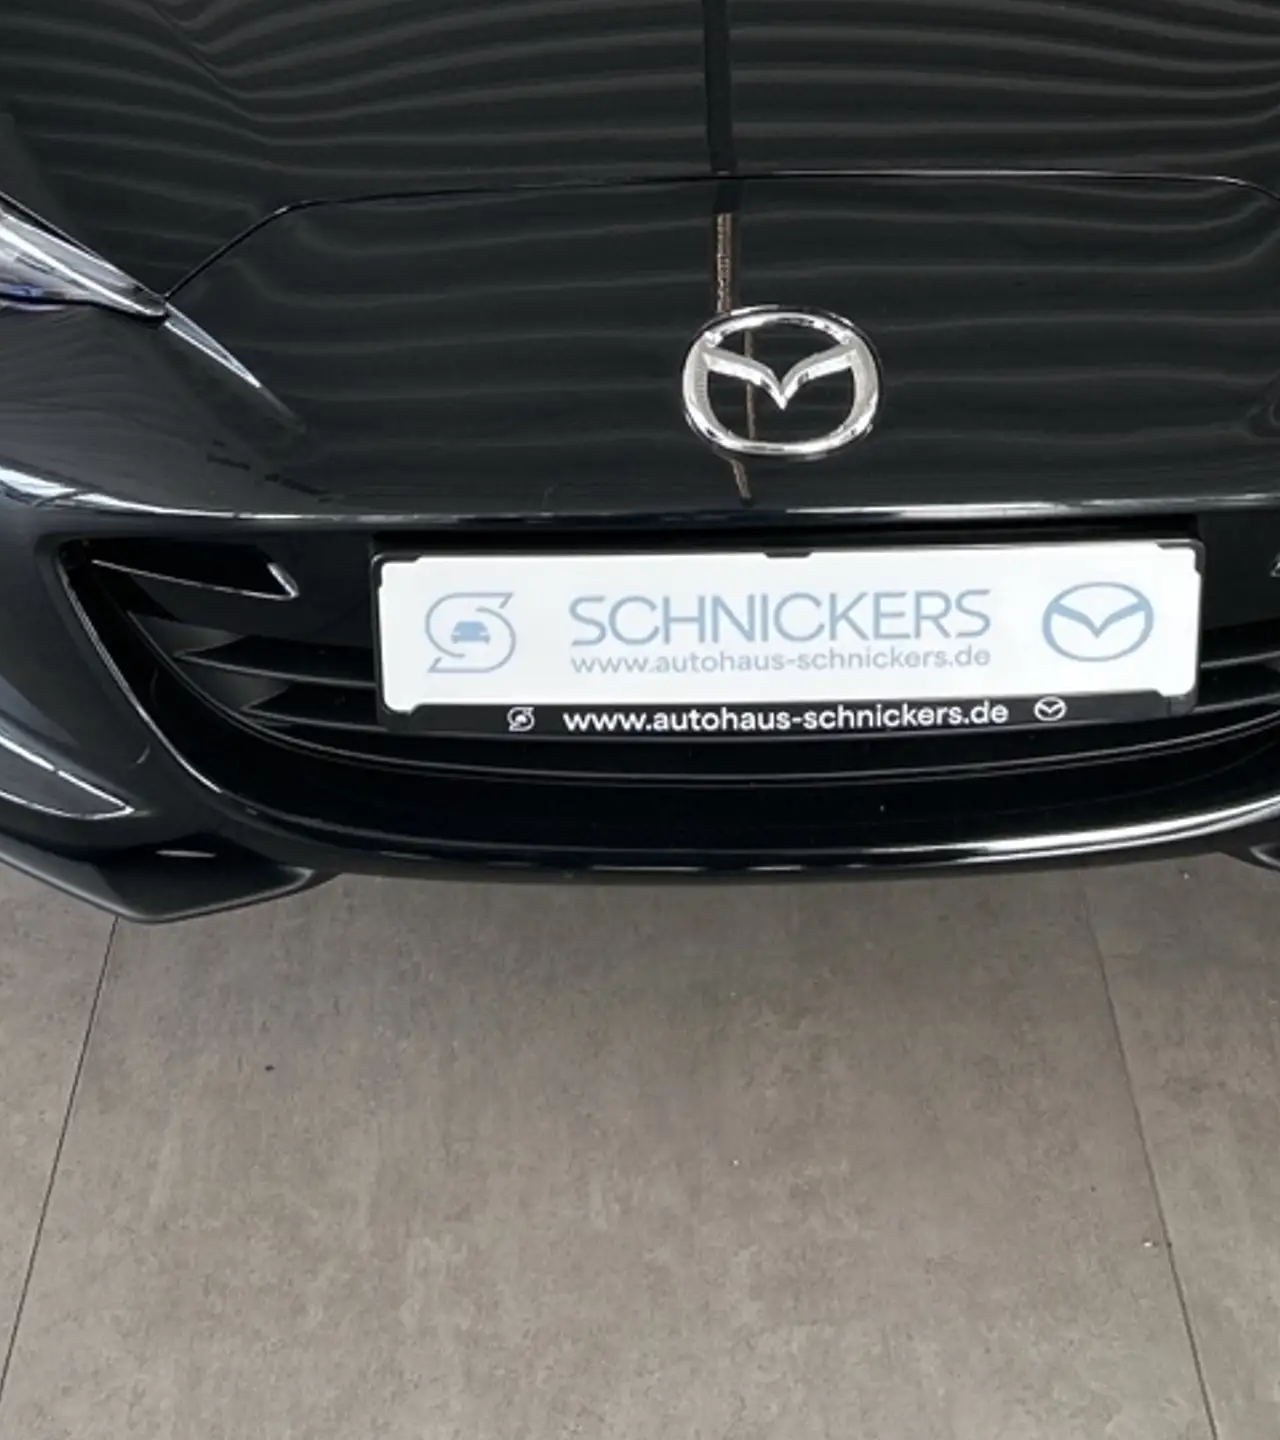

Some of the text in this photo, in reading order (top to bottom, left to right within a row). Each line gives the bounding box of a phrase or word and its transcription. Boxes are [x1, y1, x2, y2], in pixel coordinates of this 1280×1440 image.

[568, 589, 992, 647] SCHNICKERS
[570, 644, 991, 674] www.autohaus-schnickers.de
[563, 699, 1010, 733] www.autohaus-schnickers.de
